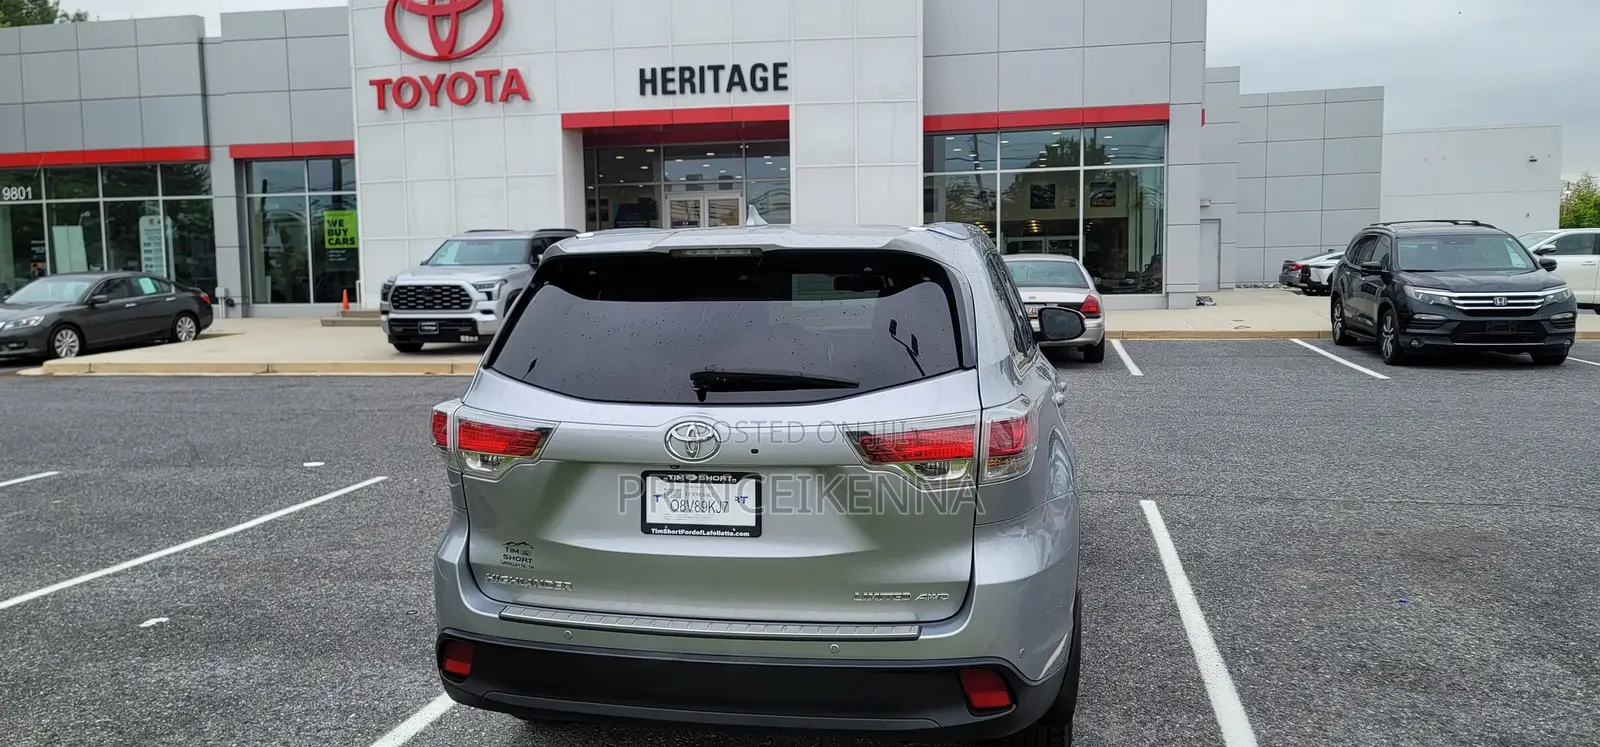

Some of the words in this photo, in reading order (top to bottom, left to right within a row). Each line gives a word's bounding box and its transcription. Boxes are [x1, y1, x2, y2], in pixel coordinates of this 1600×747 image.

[639, 62, 789, 96] HERITAGE
[369, 68, 531, 111] TOYOTA
[2, 185, 32, 200] 9801
[327, 219, 344, 227] WE
[327, 228, 348, 236] BUY
[327, 237, 356, 245] CARS
[699, 474, 733, 482] SHORT
[505, 546, 520, 554] TIM
[503, 554, 533, 564] SHORT
[485, 572, 573, 592] HIGHLANDER
[853, 592, 911, 602] LIMITED
[914, 593, 950, 602] AWD
